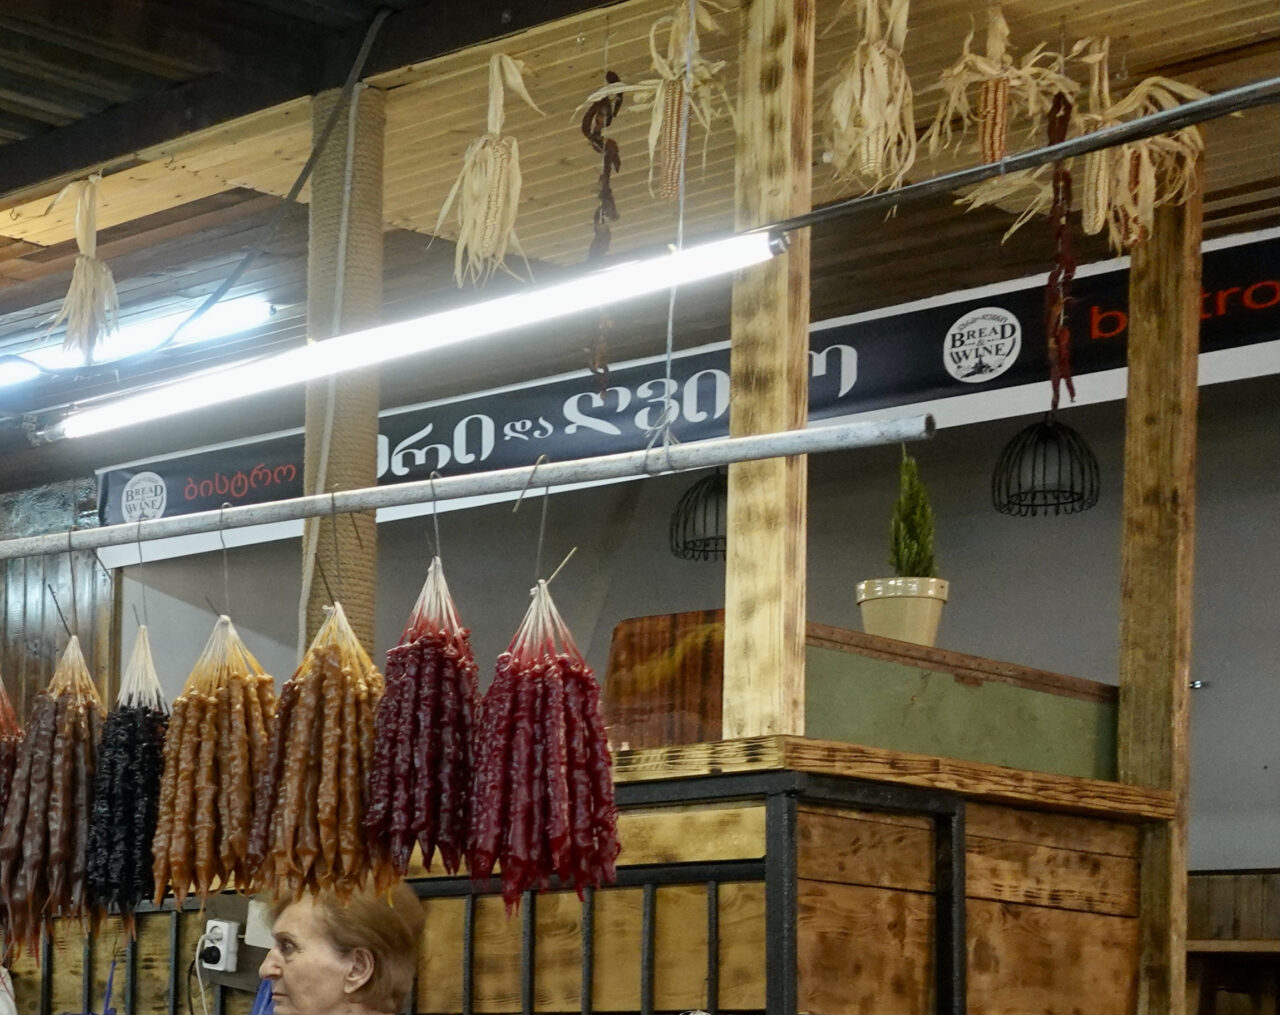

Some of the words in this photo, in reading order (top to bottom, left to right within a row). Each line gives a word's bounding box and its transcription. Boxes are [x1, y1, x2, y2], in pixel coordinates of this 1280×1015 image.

[951, 323, 1016, 348] BREAD
[951, 343, 1005, 363] WINE
[184, 463, 297, 501] ბისტრო
